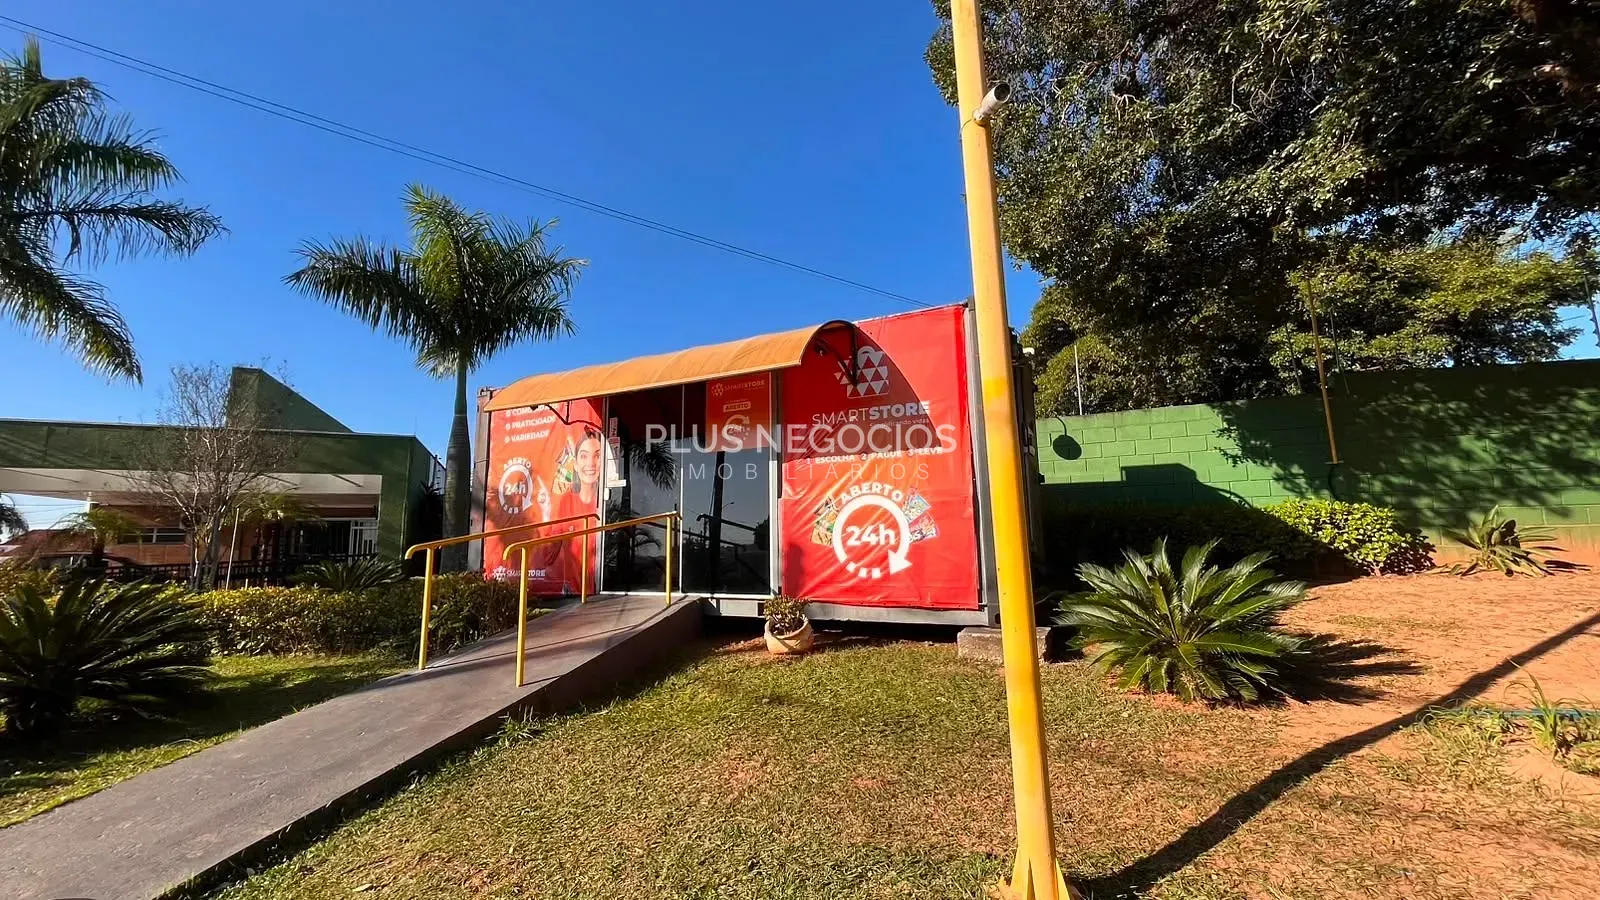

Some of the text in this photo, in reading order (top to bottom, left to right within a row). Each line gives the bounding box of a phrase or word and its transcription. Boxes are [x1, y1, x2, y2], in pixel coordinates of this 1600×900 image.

[812, 401, 930, 426] SMARTSTORE
[503, 457, 531, 471] ABERTO
[504, 482, 526, 496] 24h
[840, 481, 904, 504] ABERTO
[846, 524, 896, 547] 24h
